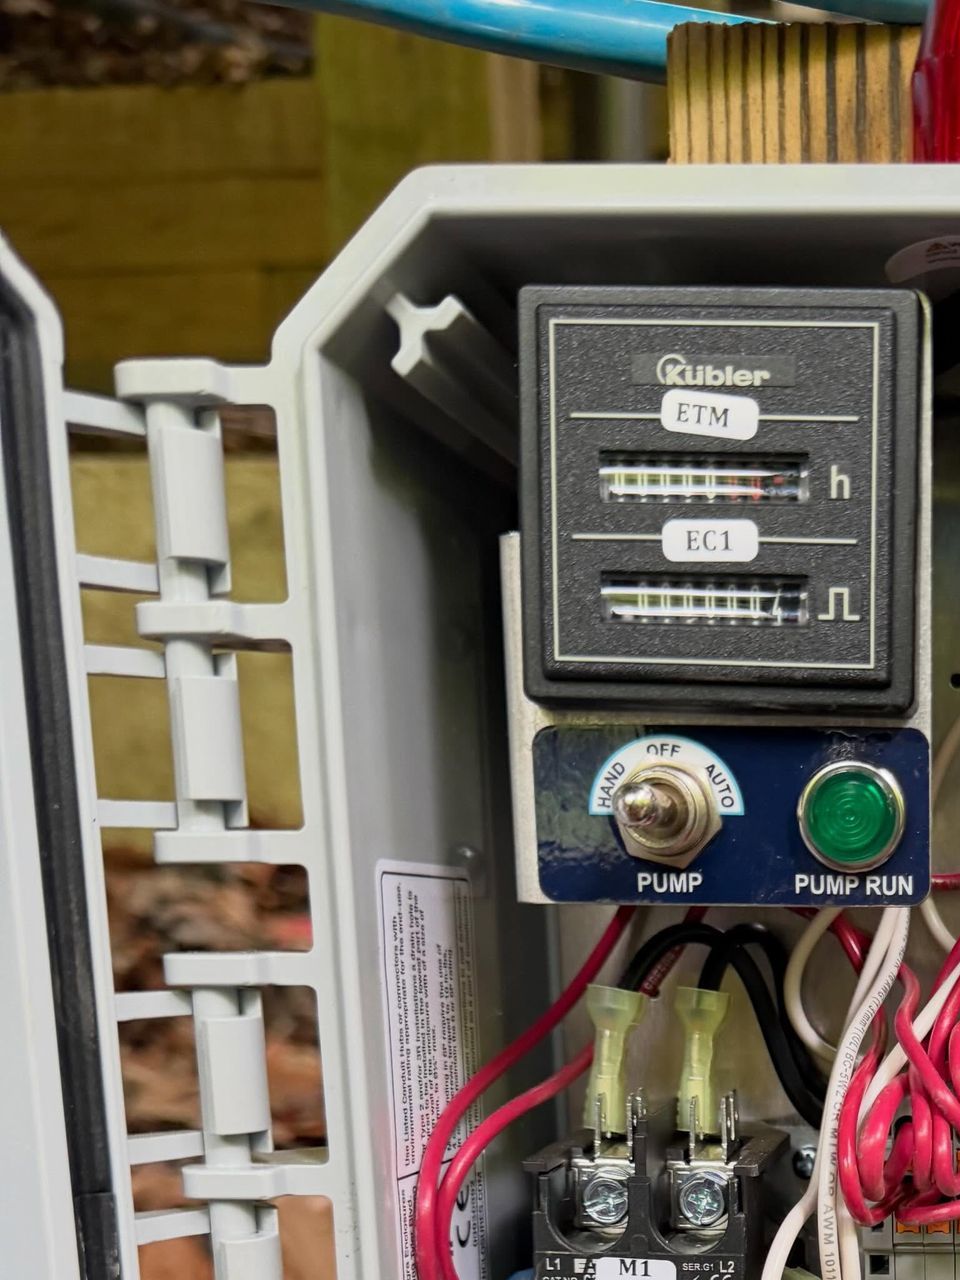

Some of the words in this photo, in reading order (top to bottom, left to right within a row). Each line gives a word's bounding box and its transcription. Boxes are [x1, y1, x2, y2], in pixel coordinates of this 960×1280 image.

[657, 354, 771, 387] Kübler
[675, 402, 730, 428] ETM
[829, 465, 850, 500] h
[686, 529, 733, 552] EC1
[646, 742, 681, 759] OFF
[597, 761, 627, 810] HAND
[704, 762, 735, 809] AUTO
[637, 872, 704, 895] PUMP
[794, 874, 860, 896] PUMP
[864, 875, 914, 897] RUN
[394, 945, 402, 1010] connectors
[397, 1013, 403, 1025] or
[401, 979, 410, 1045] appropriate
[400, 1060, 408, 1104] Conduit
[407, 1085, 415, 1164] environmental
[401, 1189, 409, 1258] Enclosures
[823, 1203, 835, 1245] AWM
[545, 1258, 561, 1271] L1
[619, 1258, 652, 1277] M1
[719, 1260, 735, 1273] L2
